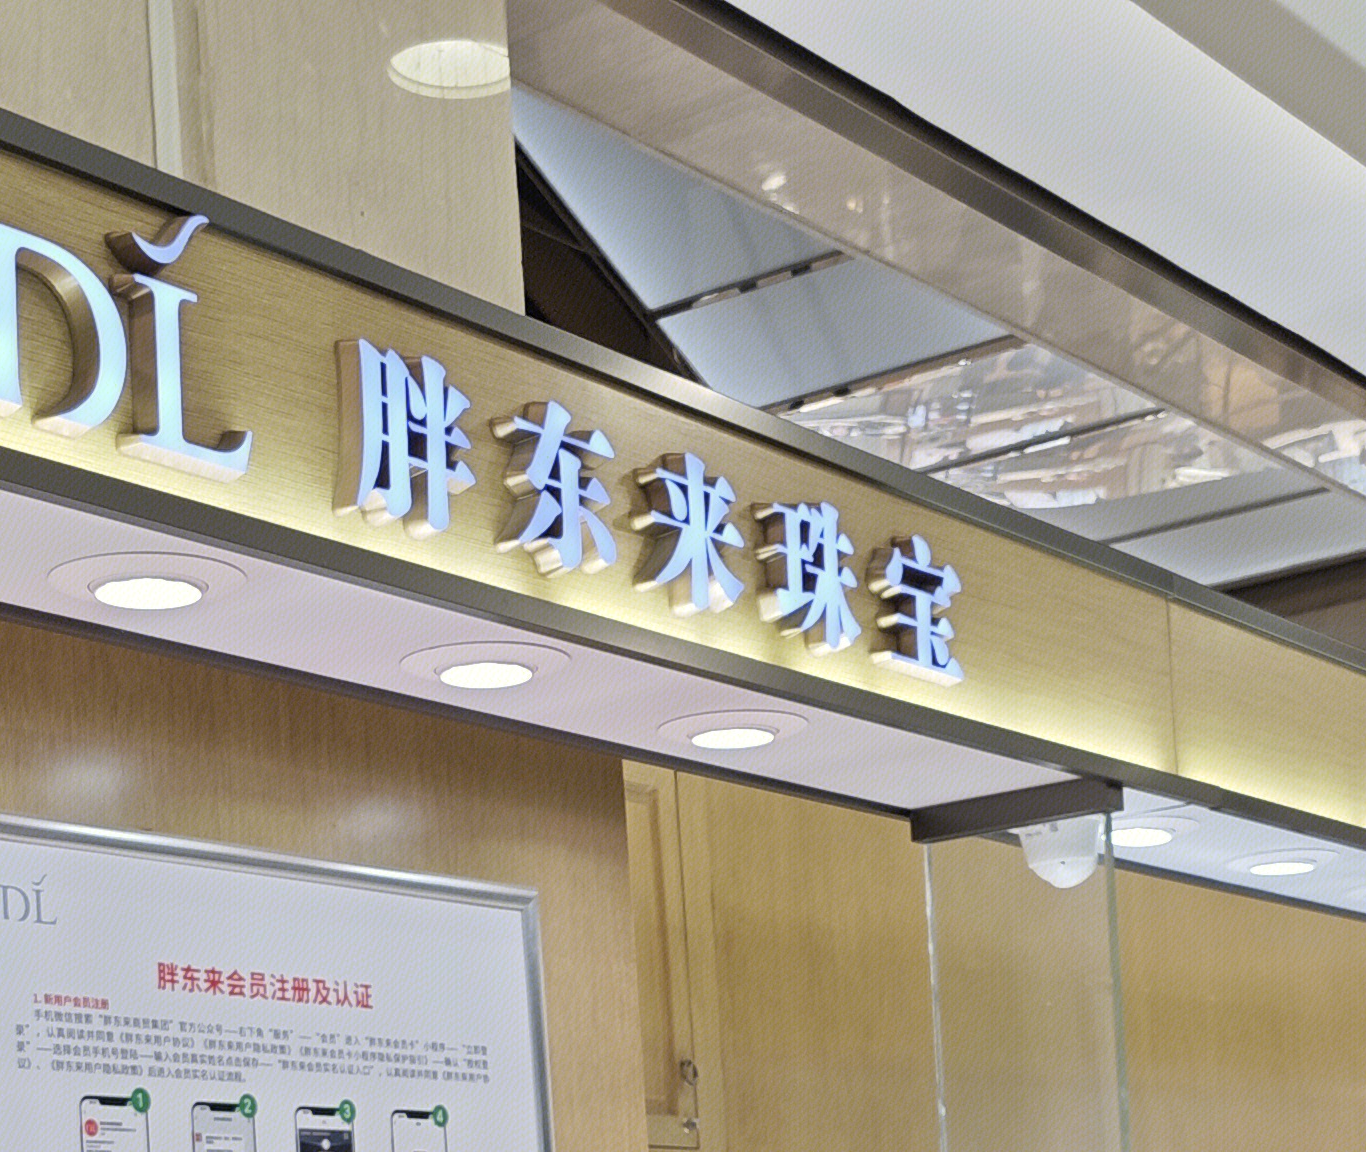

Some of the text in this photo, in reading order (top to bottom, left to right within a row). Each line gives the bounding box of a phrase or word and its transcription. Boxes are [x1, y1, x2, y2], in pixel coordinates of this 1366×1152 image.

[333, 339, 963, 687] 胖东来珠宝
[157, 962, 374, 1010] 胖东来会员注册及认证
